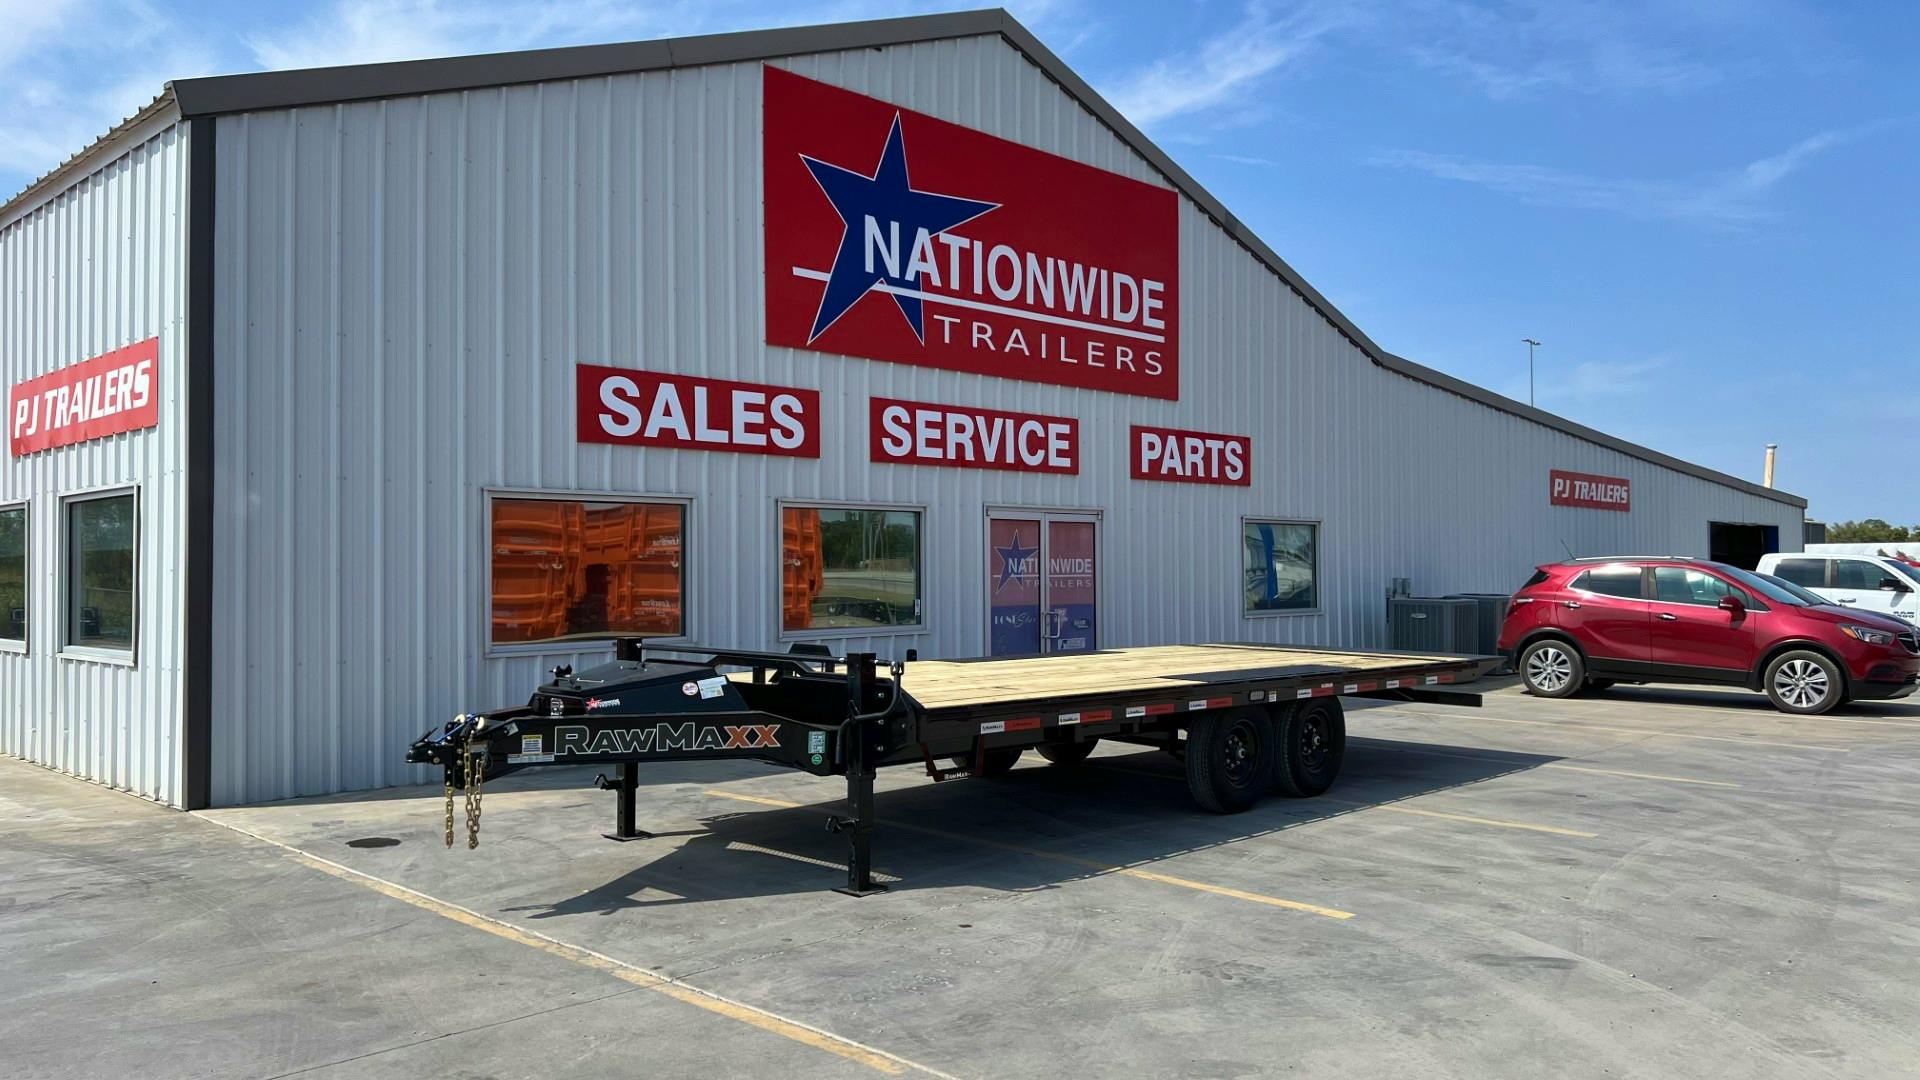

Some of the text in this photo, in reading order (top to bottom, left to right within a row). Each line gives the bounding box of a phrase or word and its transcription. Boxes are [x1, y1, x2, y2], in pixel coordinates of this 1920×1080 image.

[864, 214, 1165, 329] NATIONWIDE
[933, 314, 1163, 376] TRAILERS
[14, 359, 152, 439] PJ TRAILERS
[598, 375, 805, 450] SALES
[881, 405, 1071, 468] SERVICE
[1141, 432, 1244, 481] PARTS
[1553, 478, 1628, 504] PJ TRAILERS
[1008, 557, 1092, 574] NATINWIDE
